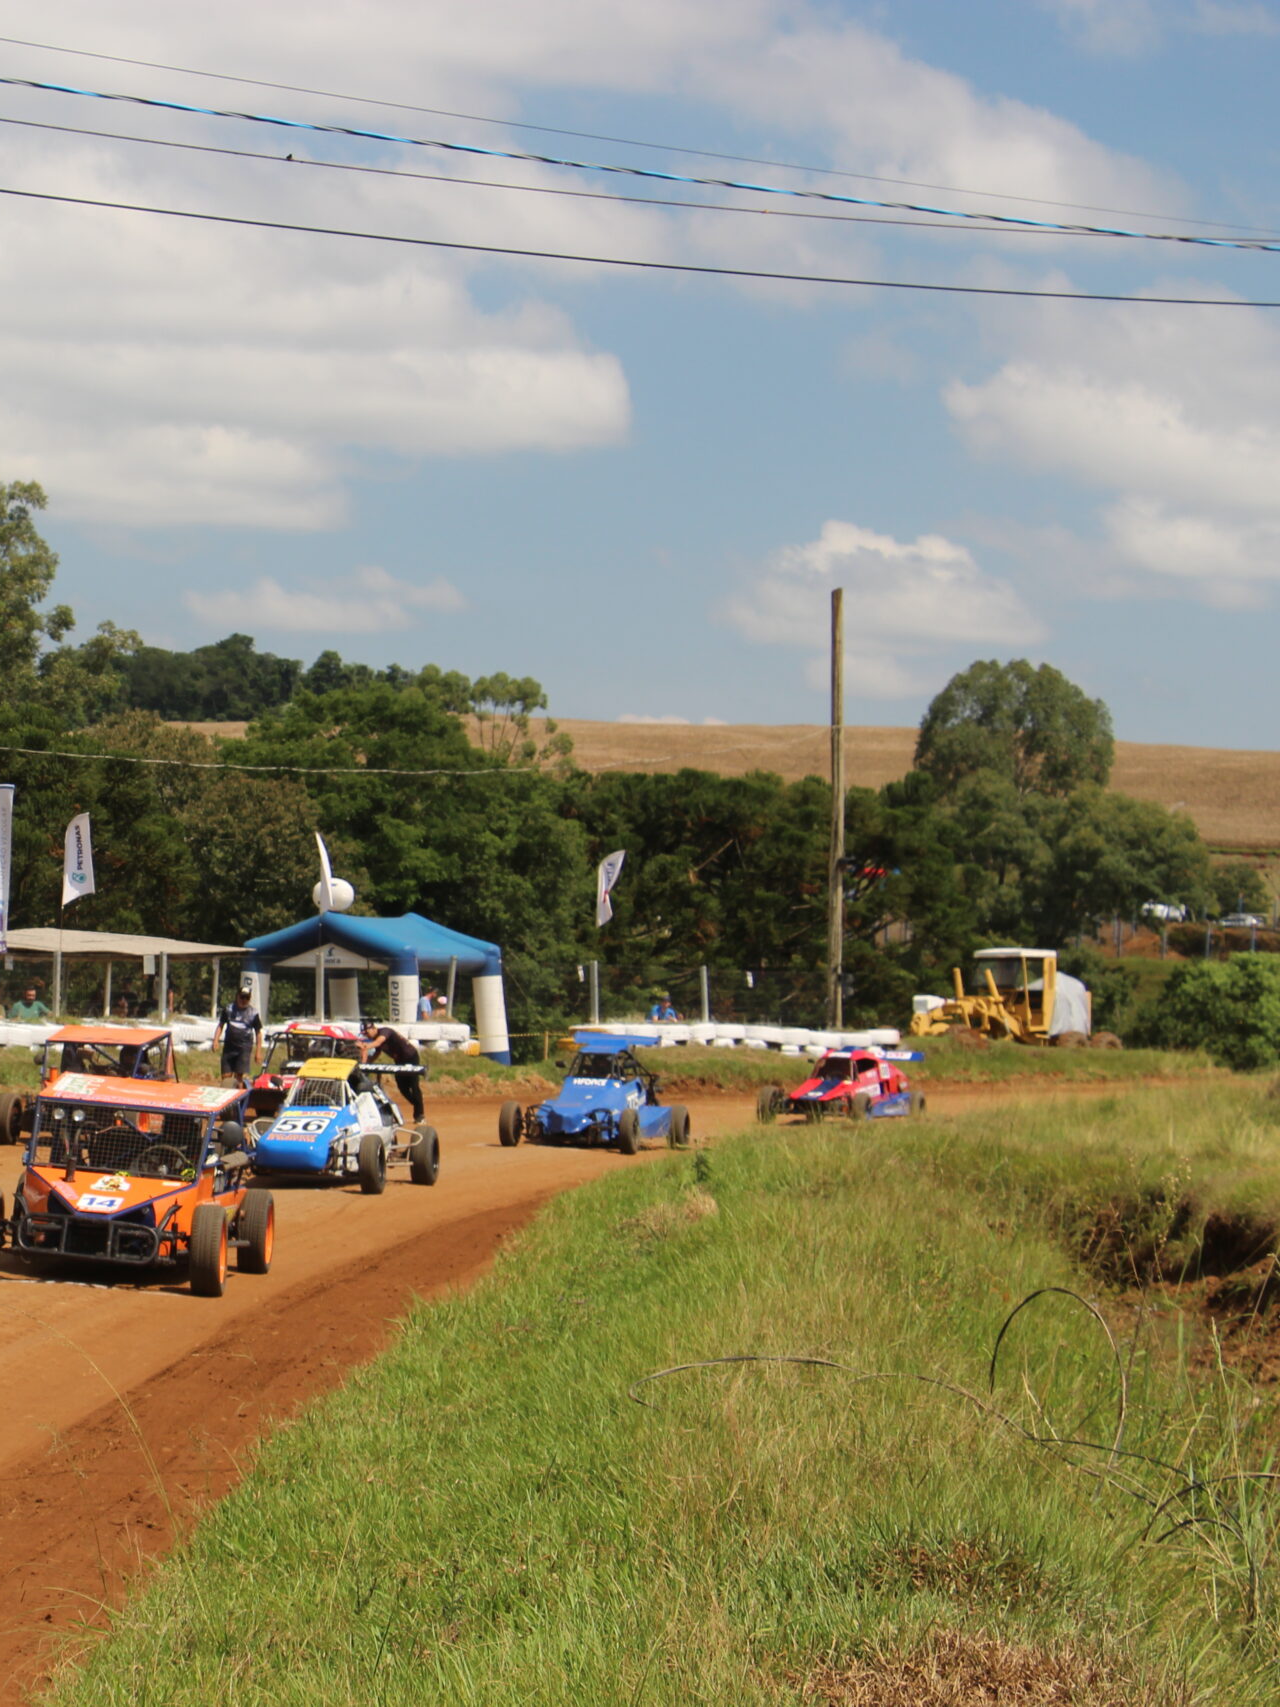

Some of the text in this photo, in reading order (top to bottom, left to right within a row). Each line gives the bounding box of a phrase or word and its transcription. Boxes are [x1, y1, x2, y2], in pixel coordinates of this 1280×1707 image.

[74, 824, 83, 871] PETRONAS
[276, 1119, 324, 1132] 56
[82, 1197, 116, 1207] 14
